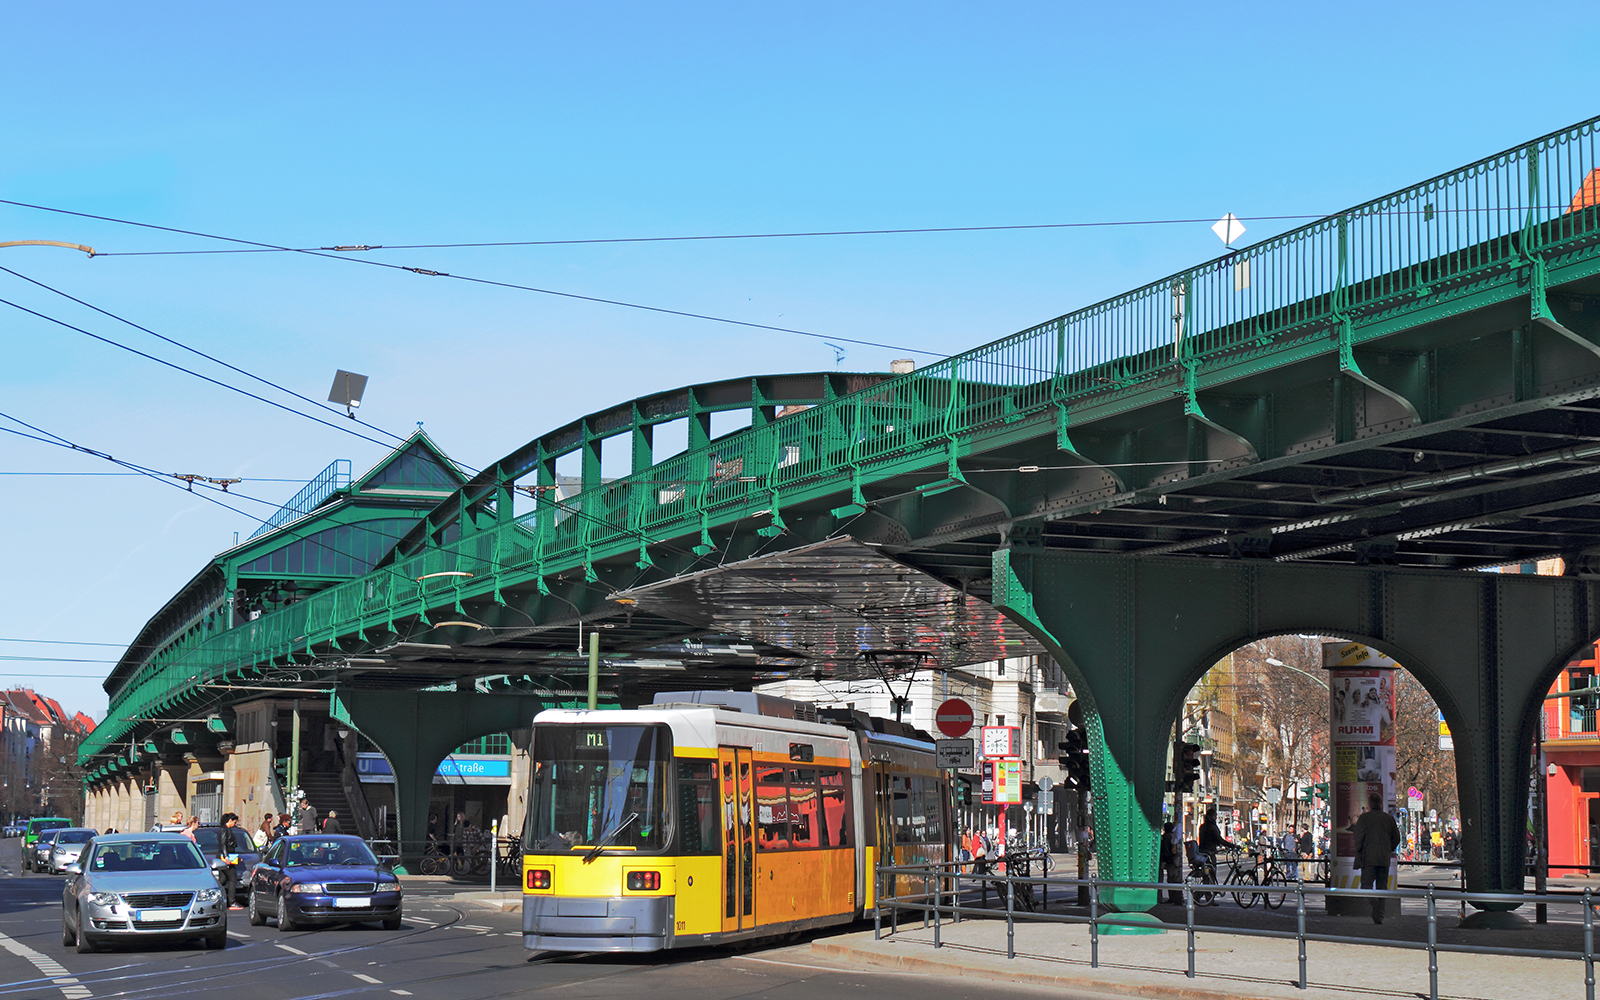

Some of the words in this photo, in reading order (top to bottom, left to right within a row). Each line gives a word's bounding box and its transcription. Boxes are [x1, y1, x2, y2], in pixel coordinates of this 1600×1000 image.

[1341, 645, 1359, 658] Szene
[1356, 650, 1369, 661] Info
[1338, 725, 1374, 735] RUHM
[586, 732, 604, 747] M1
[358, 759, 370, 773] U
[676, 920, 686, 931] 1011
